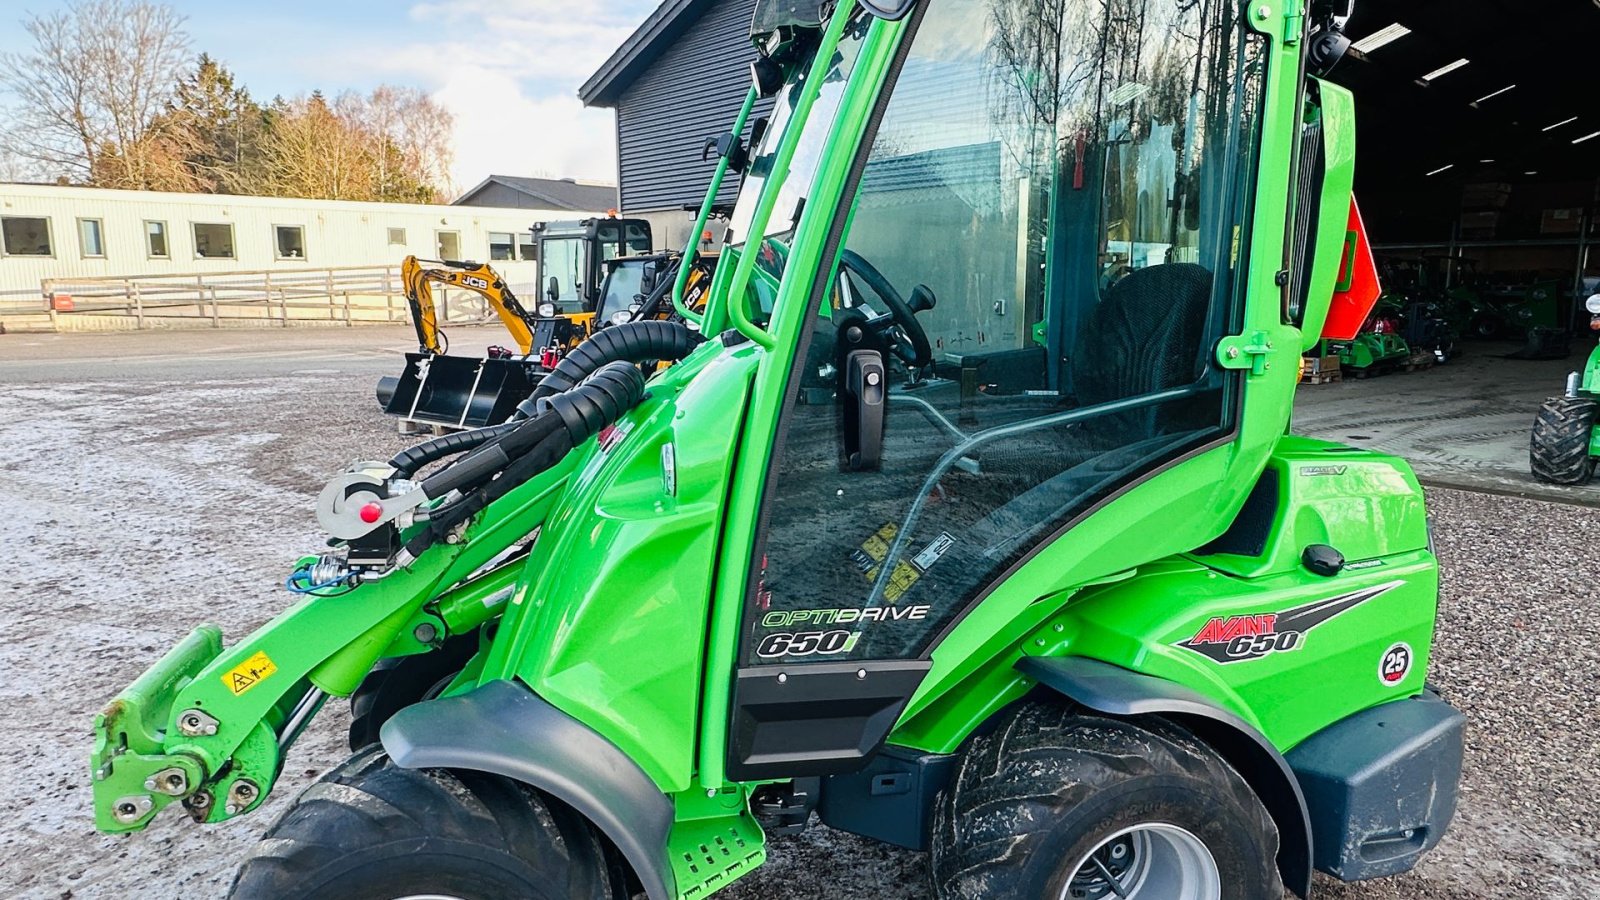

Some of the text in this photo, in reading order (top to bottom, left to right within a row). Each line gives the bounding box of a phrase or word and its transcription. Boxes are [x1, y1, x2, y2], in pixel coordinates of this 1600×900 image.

[462, 275, 487, 290] JCB
[762, 605, 931, 627] OPTIDRIVE
[1189, 613, 1277, 645] AVANT
[756, 629, 862, 658] 650i
[1385, 651, 1406, 674] 25
